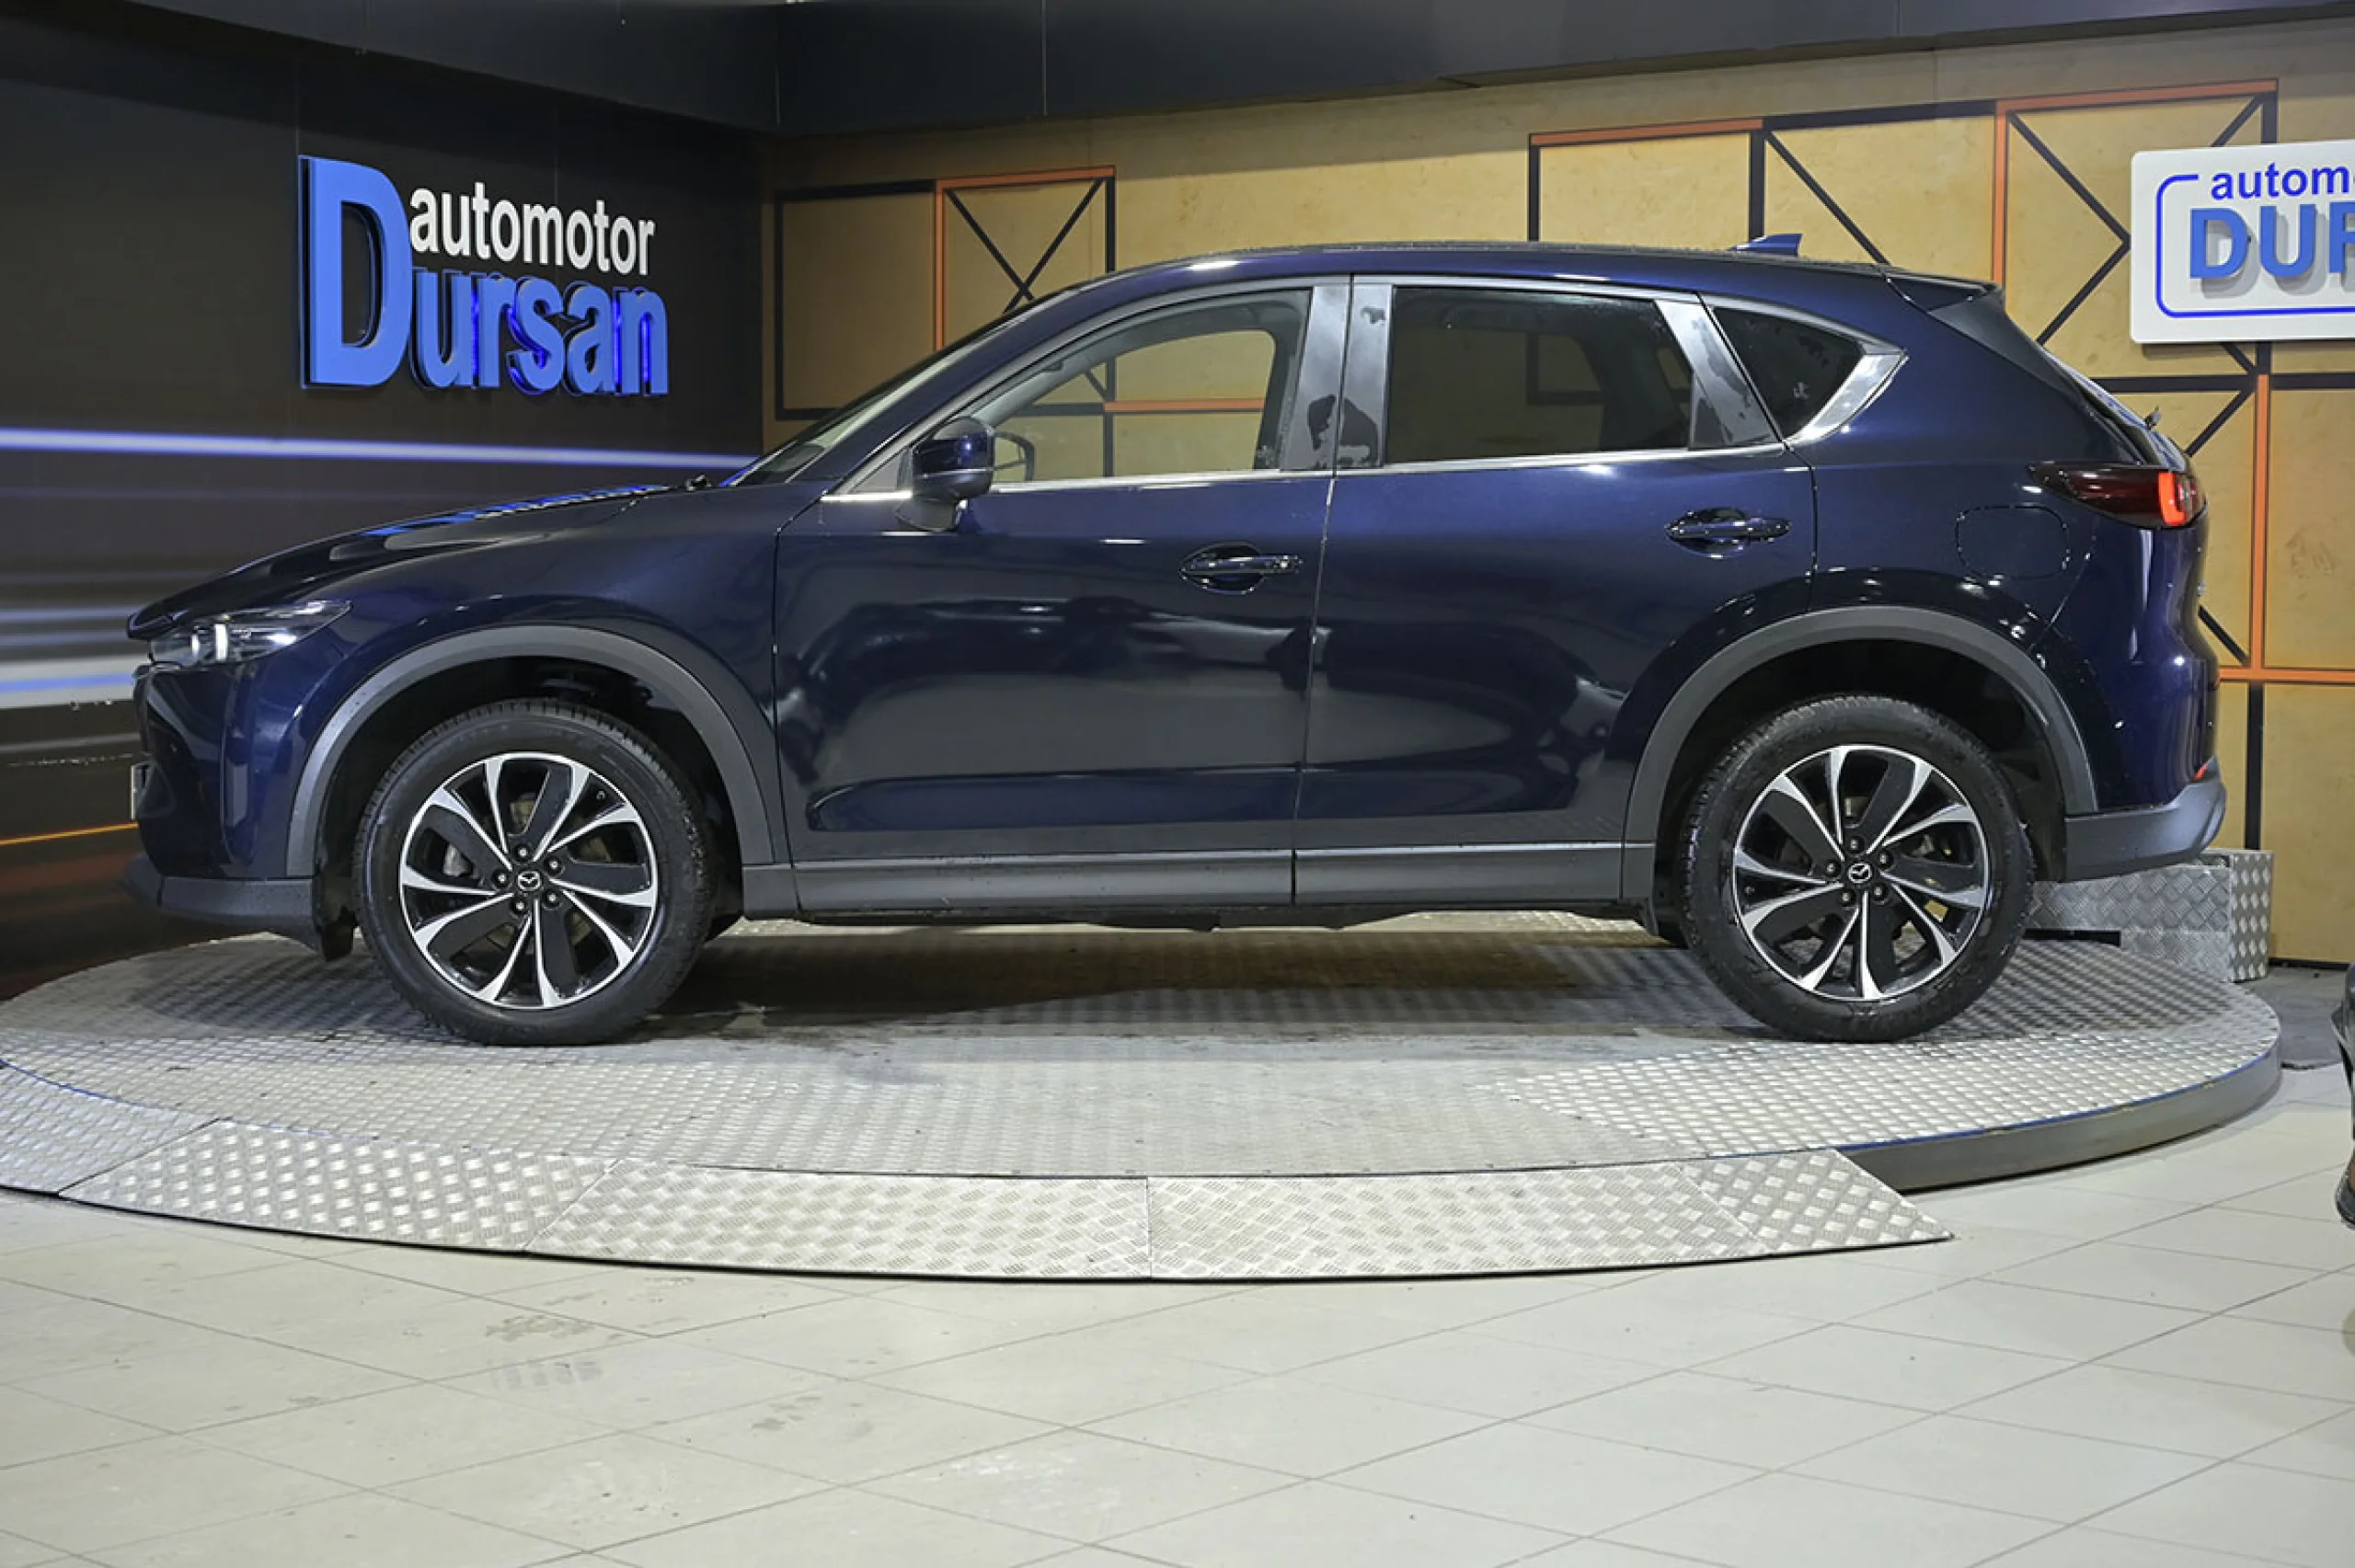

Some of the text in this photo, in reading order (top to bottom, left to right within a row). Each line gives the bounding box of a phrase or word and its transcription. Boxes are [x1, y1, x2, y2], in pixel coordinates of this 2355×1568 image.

[2211, 163, 2355, 200] autom
[410, 182, 655, 275] automotor
[298, 155, 669, 396] Dursan
